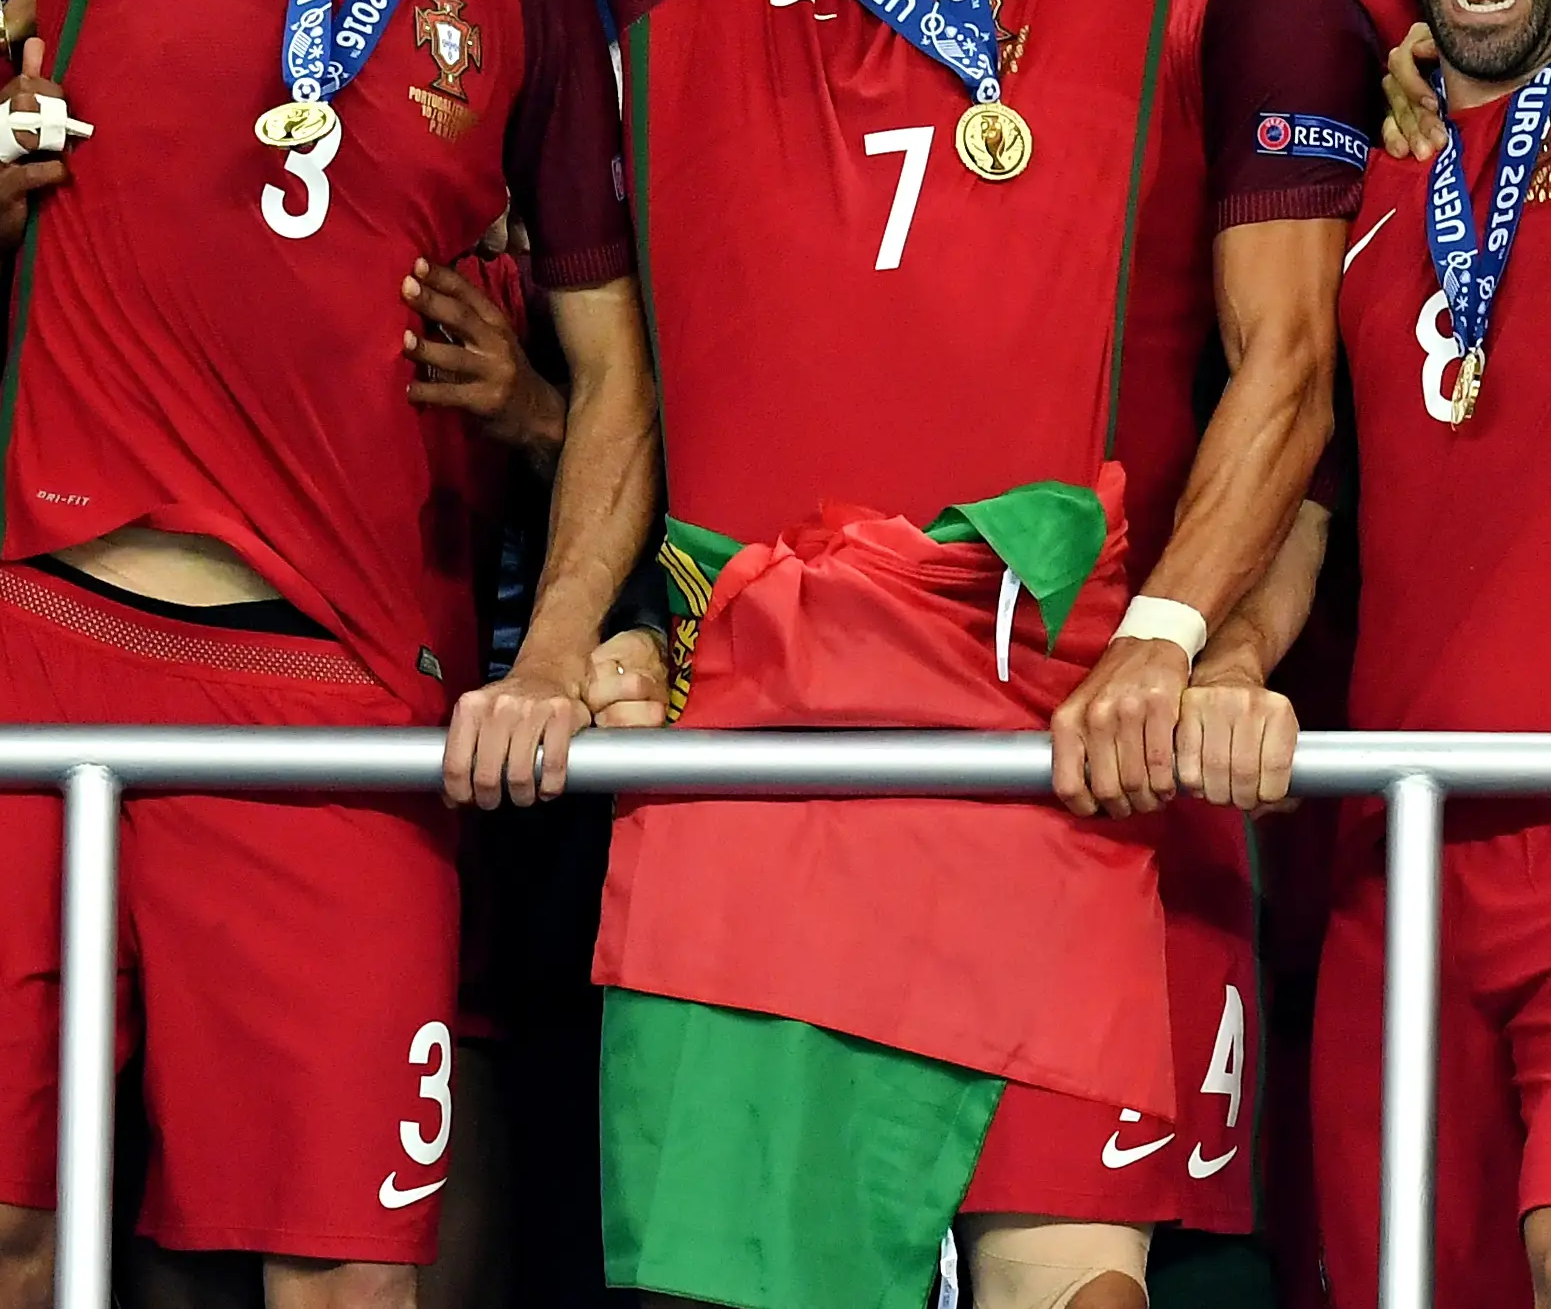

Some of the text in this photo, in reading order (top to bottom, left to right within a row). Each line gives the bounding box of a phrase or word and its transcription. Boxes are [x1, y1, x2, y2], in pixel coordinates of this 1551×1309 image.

[261, 111, 342, 239] 3
[864, 126, 935, 270] 7
[1293, 125, 1369, 163] RESPECT
[1433, 163, 1466, 244] UEFA
[1487, 164, 1525, 253] 2016
[36, 489, 90, 507] DRI-FIT
[399, 1021, 453, 1166] 3
[1200, 983, 1245, 1128] 4
